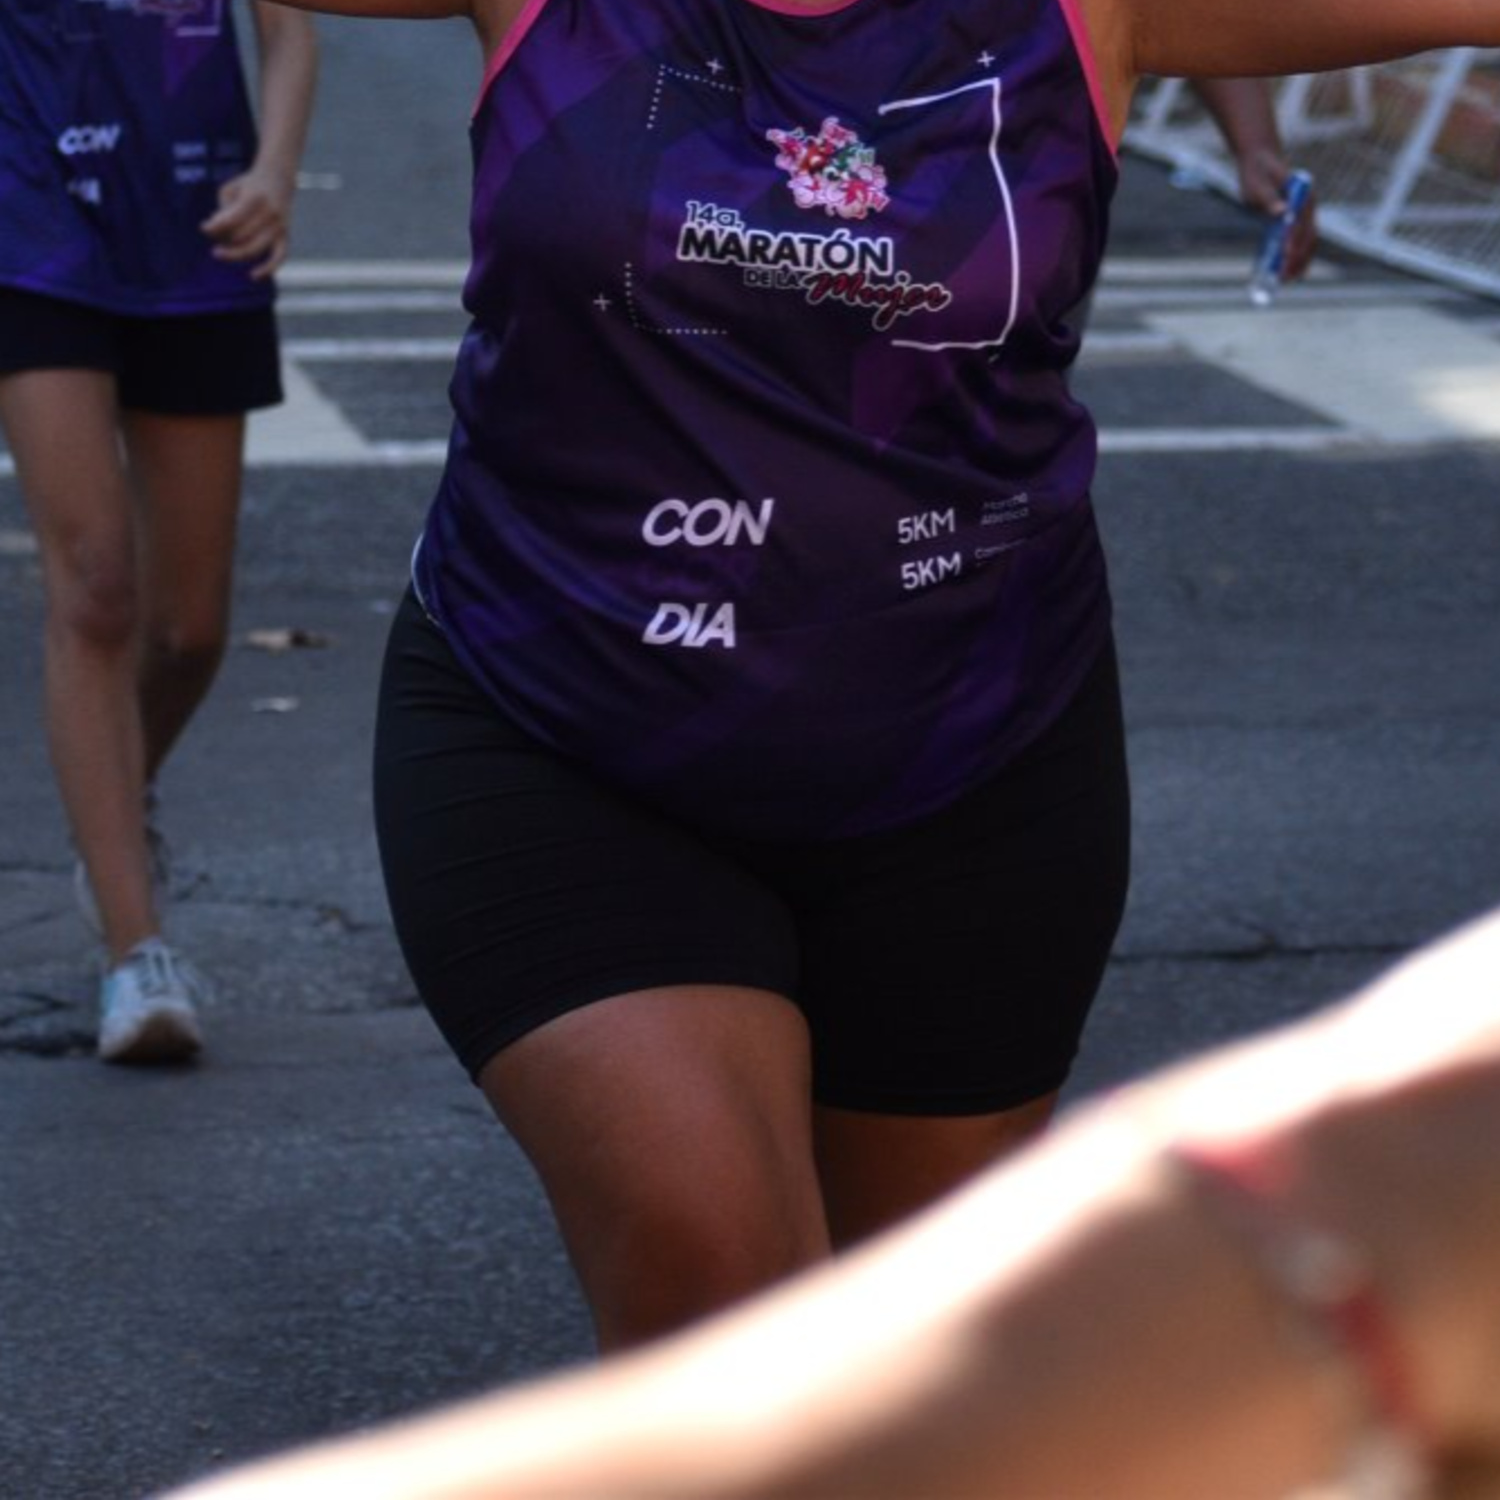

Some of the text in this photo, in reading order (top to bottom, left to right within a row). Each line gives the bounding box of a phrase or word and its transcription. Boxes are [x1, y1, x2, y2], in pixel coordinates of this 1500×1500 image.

[677, 226, 896, 277] MARATÓN
[744, 268, 772, 288] DE
[801, 270, 952, 331] Mujer
[641, 498, 775, 547] CON
[897, 507, 957, 545] 5KM
[901, 551, 962, 590] 5KM
[641, 602, 736, 649] DIA
